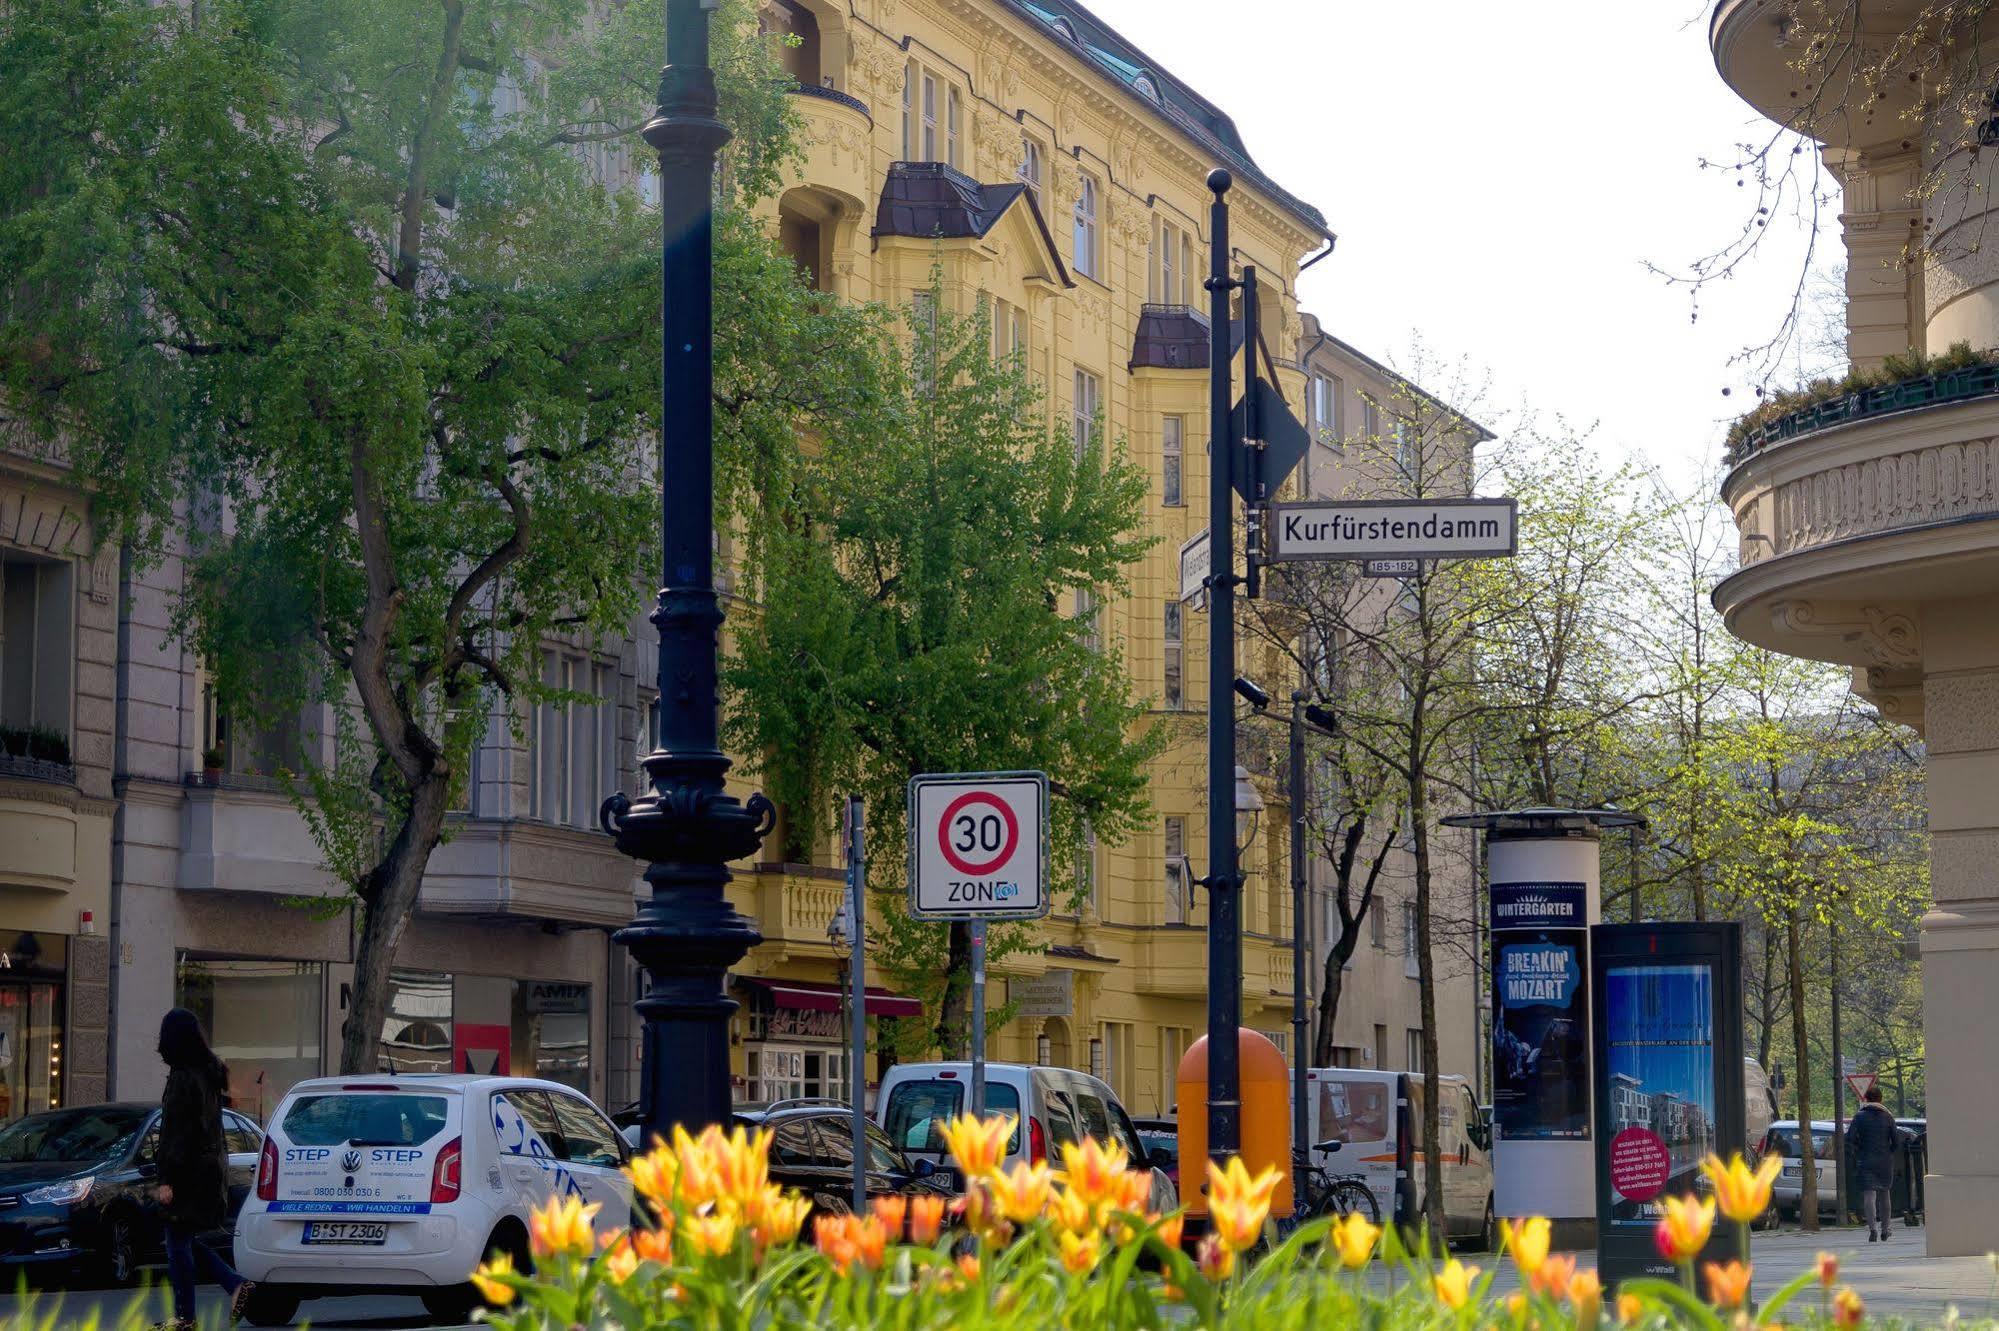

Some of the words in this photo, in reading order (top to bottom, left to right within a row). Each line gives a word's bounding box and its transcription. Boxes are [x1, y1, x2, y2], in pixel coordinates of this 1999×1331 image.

[1285, 512, 1499, 542] Kurfürstendamm
[1372, 561, 1415, 571] 185-182
[955, 814, 1001, 852] 30
[1497, 902, 1573, 917] WINTERGARTEN
[1508, 980, 1565, 1000] MOZART
[286, 1150, 330, 1161] STEP
[372, 1150, 423, 1162] STEP
[314, 1187, 334, 1196] 0800
[337, 1187, 354, 1197] 030
[356, 1187, 372, 1197] 030
[375, 1188, 381, 1197] 6
[281, 1203, 304, 1211] VIELE
[304, 1204, 333, 1212] REDEN
[346, 1204, 365, 1212] WIR
[311, 1224, 321, 1238] B
[329, 1224, 349, 1238] ST
[350, 1225, 384, 1239] 2306
